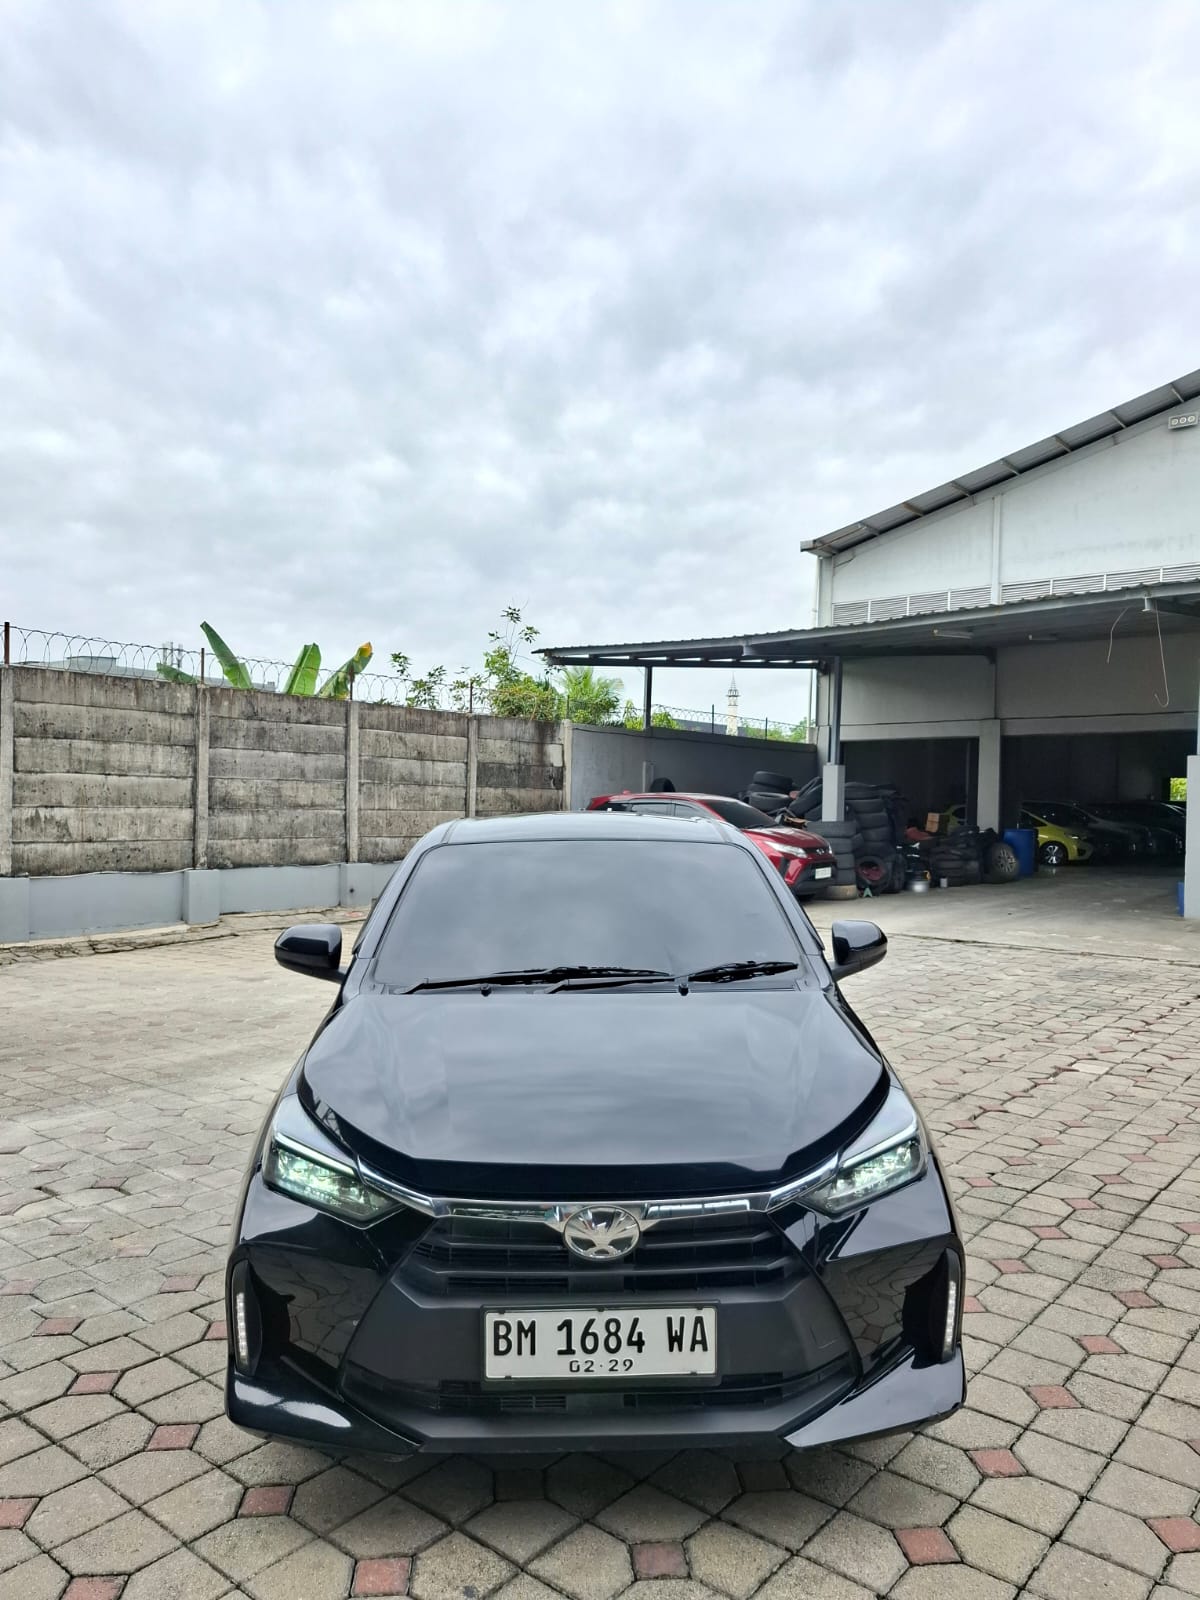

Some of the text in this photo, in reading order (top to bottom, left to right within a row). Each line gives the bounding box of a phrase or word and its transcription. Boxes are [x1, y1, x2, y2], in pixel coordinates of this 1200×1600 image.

[493, 1316, 709, 1356] BM 1684 WA
